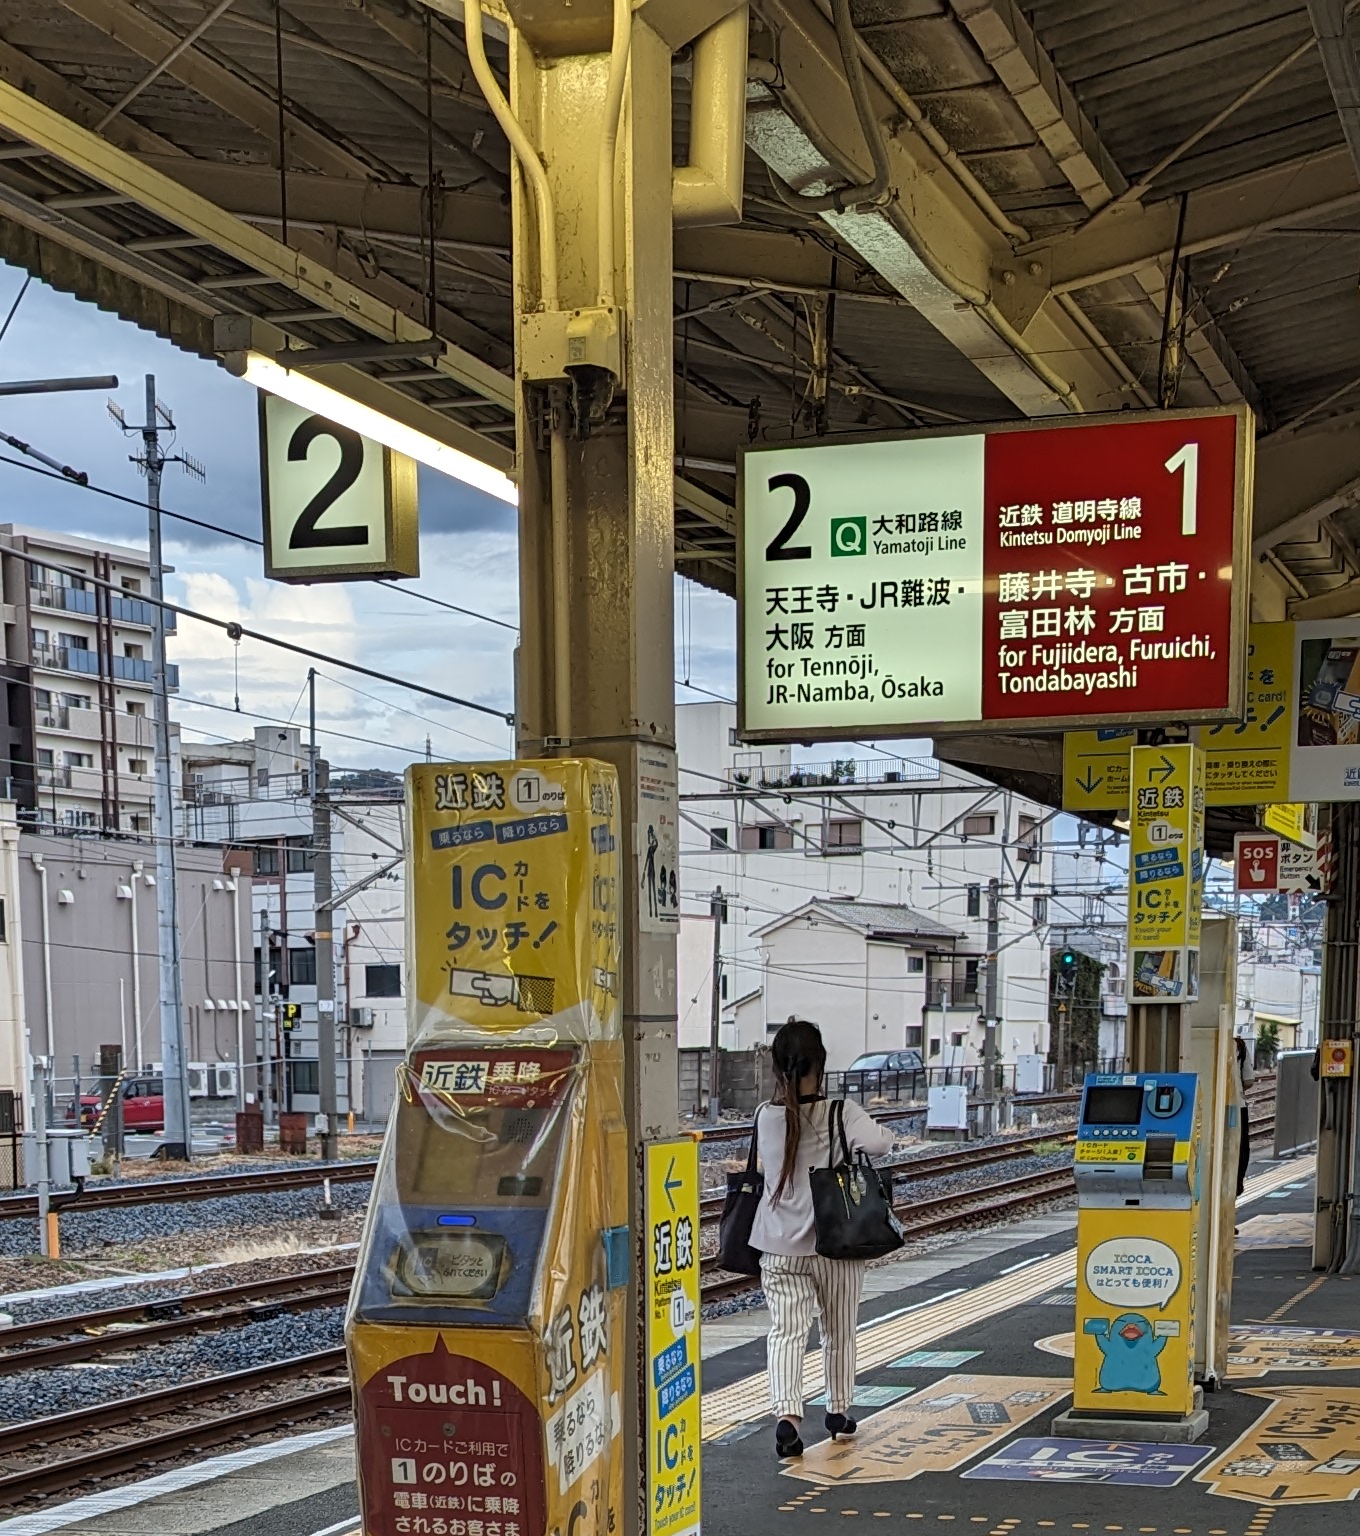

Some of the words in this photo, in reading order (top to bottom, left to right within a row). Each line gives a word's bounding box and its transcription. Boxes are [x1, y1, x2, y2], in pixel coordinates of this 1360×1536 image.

[287, 413, 369, 549] 2
[1164, 442, 1199, 536] 1
[764, 473, 812, 562] 2
[871, 510, 964, 537] 大和路線
[998, 504, 1043, 528] 近鉄
[1051, 497, 1143, 525] 道明寺線
[835, 521, 862, 555] Q
[872, 535, 935, 558] Yamatoji
[936, 535, 967, 552] Line
[999, 526, 1054, 548] Kintetsu
[1056, 525, 1112, 548] Domyoji
[1113, 523, 1142, 543] Line
[765, 577, 967, 617] 天王寺・JR難波・
[998, 562, 1208, 604] 藤井寺・古市・
[765, 623, 815, 652] 大阪
[824, 624, 867, 649] 方面
[998, 605, 1097, 641] 富田林
[1108, 605, 1166, 634] 方面
[998, 645, 1028, 669] for
[1030, 642, 1126, 668] Fujiidera,
[1129, 634, 1217, 665] Furuichi,
[766, 656, 796, 680] for
[799, 654, 880, 681] Tennōji,
[998, 666, 1138, 696] Tondabayashi
[765, 679, 876, 705] JR-Namba,
[880, 675, 945, 700] Ōsaka
[435, 772, 506, 811] 近鉄
[1138, 786, 1185, 809] 近鉄
[501, 818, 561, 840] 降りるなら
[1137, 810, 1170, 818] Kintetsu
[439, 829, 485, 846] 乗るなら
[1243, 847, 1274, 859] SOS
[1280, 854, 1313, 864] ボタン
[452, 863, 508, 911] IC
[446, 920, 558, 952] タッチ！
[287, 1004, 297, 1018] P
[420, 1062, 488, 1093] 近鉄
[492, 1062, 542, 1083] 乗降
[654, 1215, 694, 1278] 近鉄
[1113, 1254, 1153, 1264] ICOCA
[1093, 1265, 1133, 1275] SMART
[1135, 1266, 1174, 1276] ICOCA
[1096, 1278, 1168, 1288] はとっても便利！
[546, 1286, 608, 1408] 近鉄
[657, 1345, 684, 1375] 乗るなら
[387, 1375, 502, 1407] Touch!
[395, 1438, 509, 1458] ICカードご利用で
[657, 1423, 679, 1474] IC
